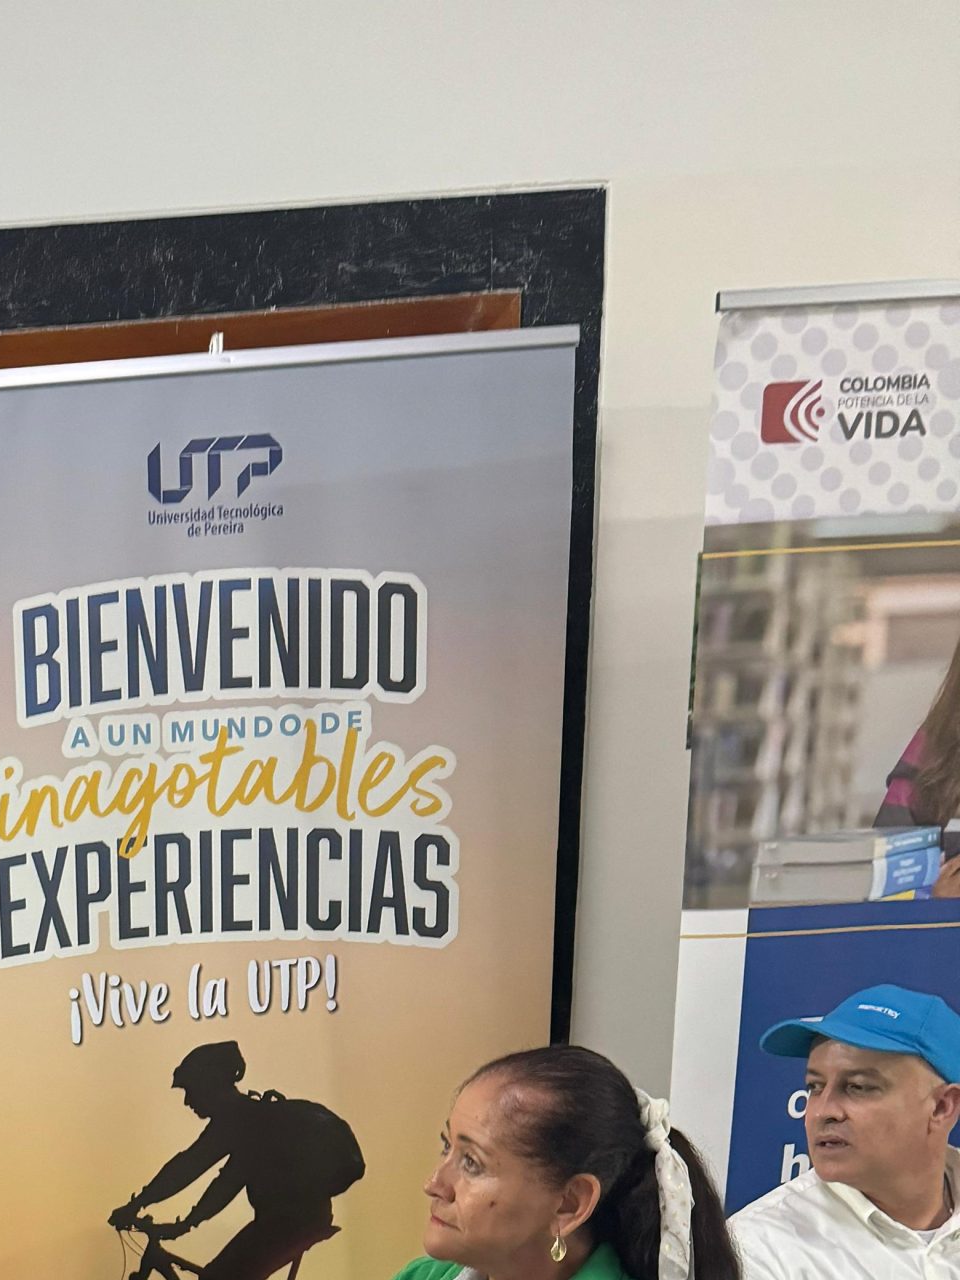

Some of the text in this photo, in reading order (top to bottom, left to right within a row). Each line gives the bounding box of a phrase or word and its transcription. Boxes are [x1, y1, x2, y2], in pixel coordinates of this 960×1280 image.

[839, 373, 930, 394] COLOMBIA
[837, 392, 929, 409] POTENCIA DE LA
[837, 408, 926, 440] VIDA
[147, 433, 283, 504] UTP
[148, 503, 284, 525] Universidad Tecnológica
[187, 521, 244, 538] de Pereira
[22, 576, 418, 719] BIENVENIDO
[70, 710, 363, 749] A UN MUNDO DE
[68, 954, 338, 1045] ¡Vive la UTP!
